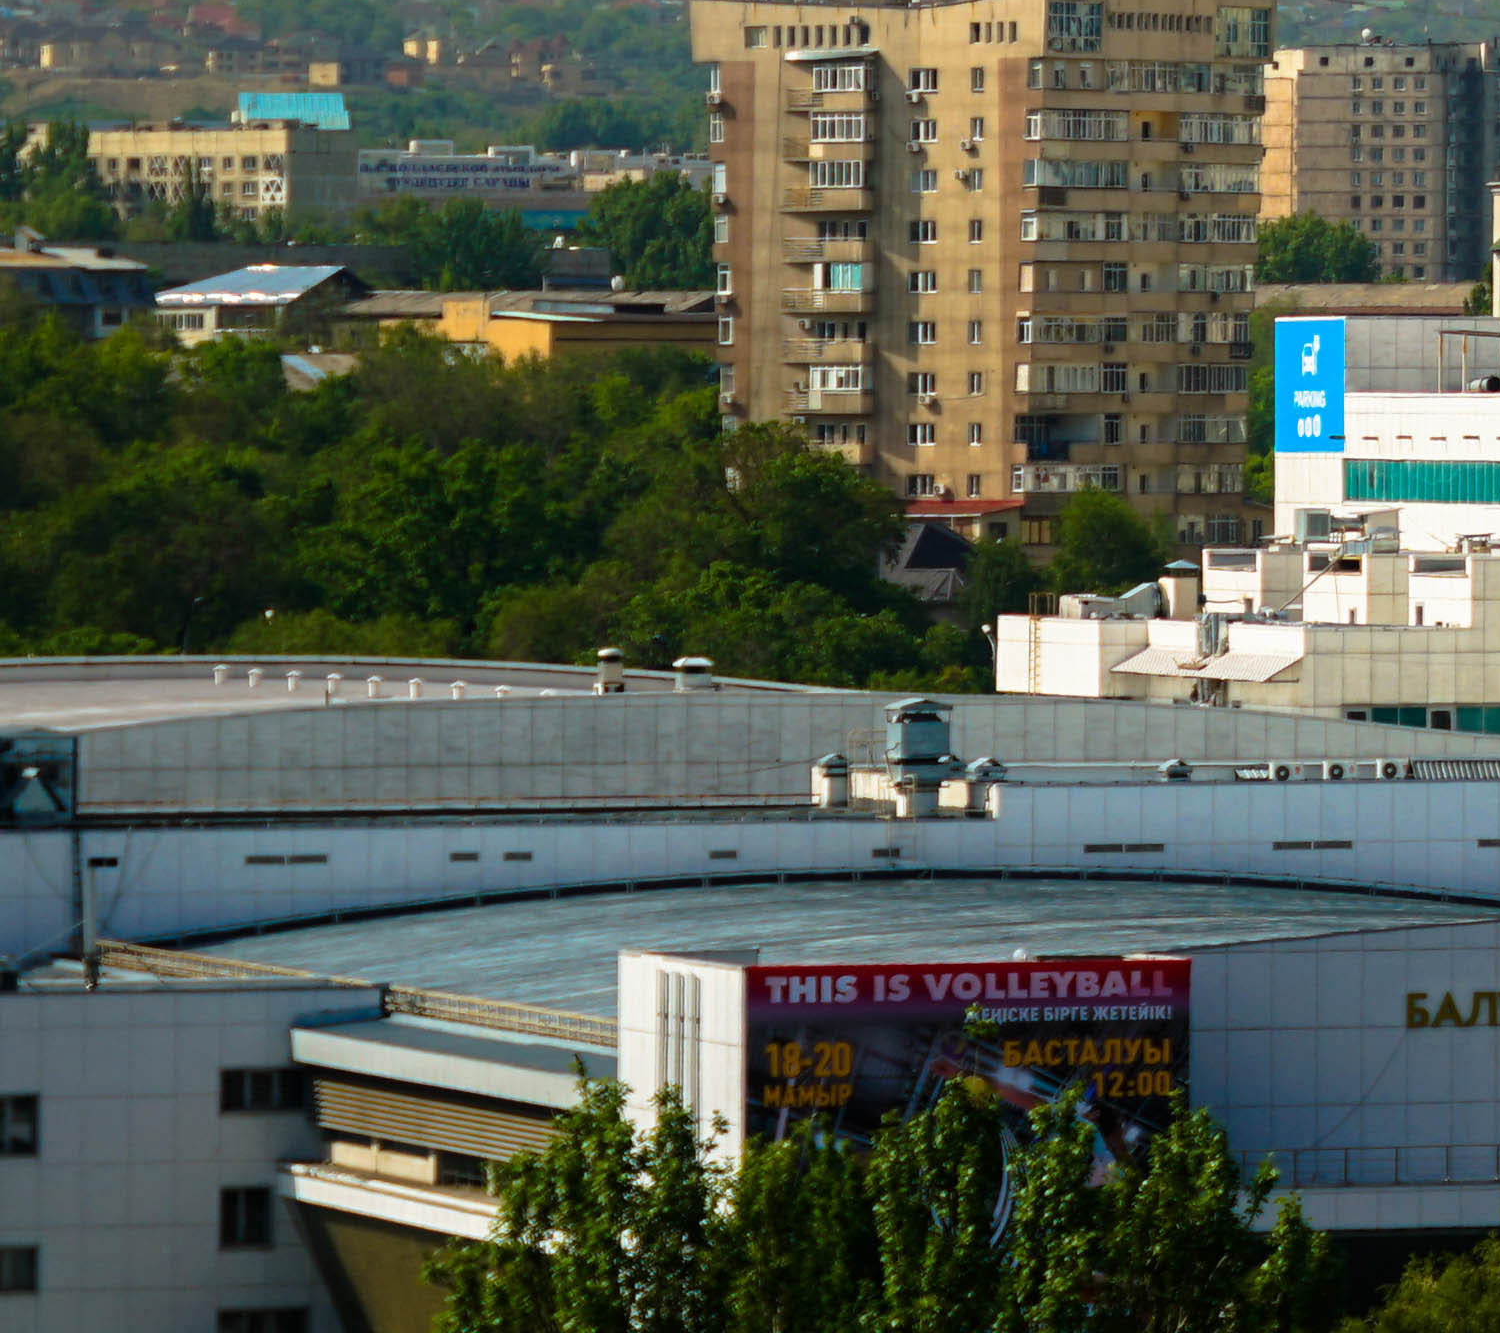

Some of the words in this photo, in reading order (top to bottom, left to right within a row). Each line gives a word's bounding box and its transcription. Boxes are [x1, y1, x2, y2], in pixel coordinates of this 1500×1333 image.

[765, 975, 859, 1004] THIS
[873, 974, 911, 1002] IS
[922, 970, 1173, 1001] VOLLEYBALL
[1043, 1005, 1088, 1021] БІРГЕ
[765, 1042, 852, 1077] 18-20
[1003, 1037, 1171, 1067] БАСТАЛУЫ
[763, 1085, 852, 1107] МАМЫР
[1092, 1070, 1171, 1097] 12:00
